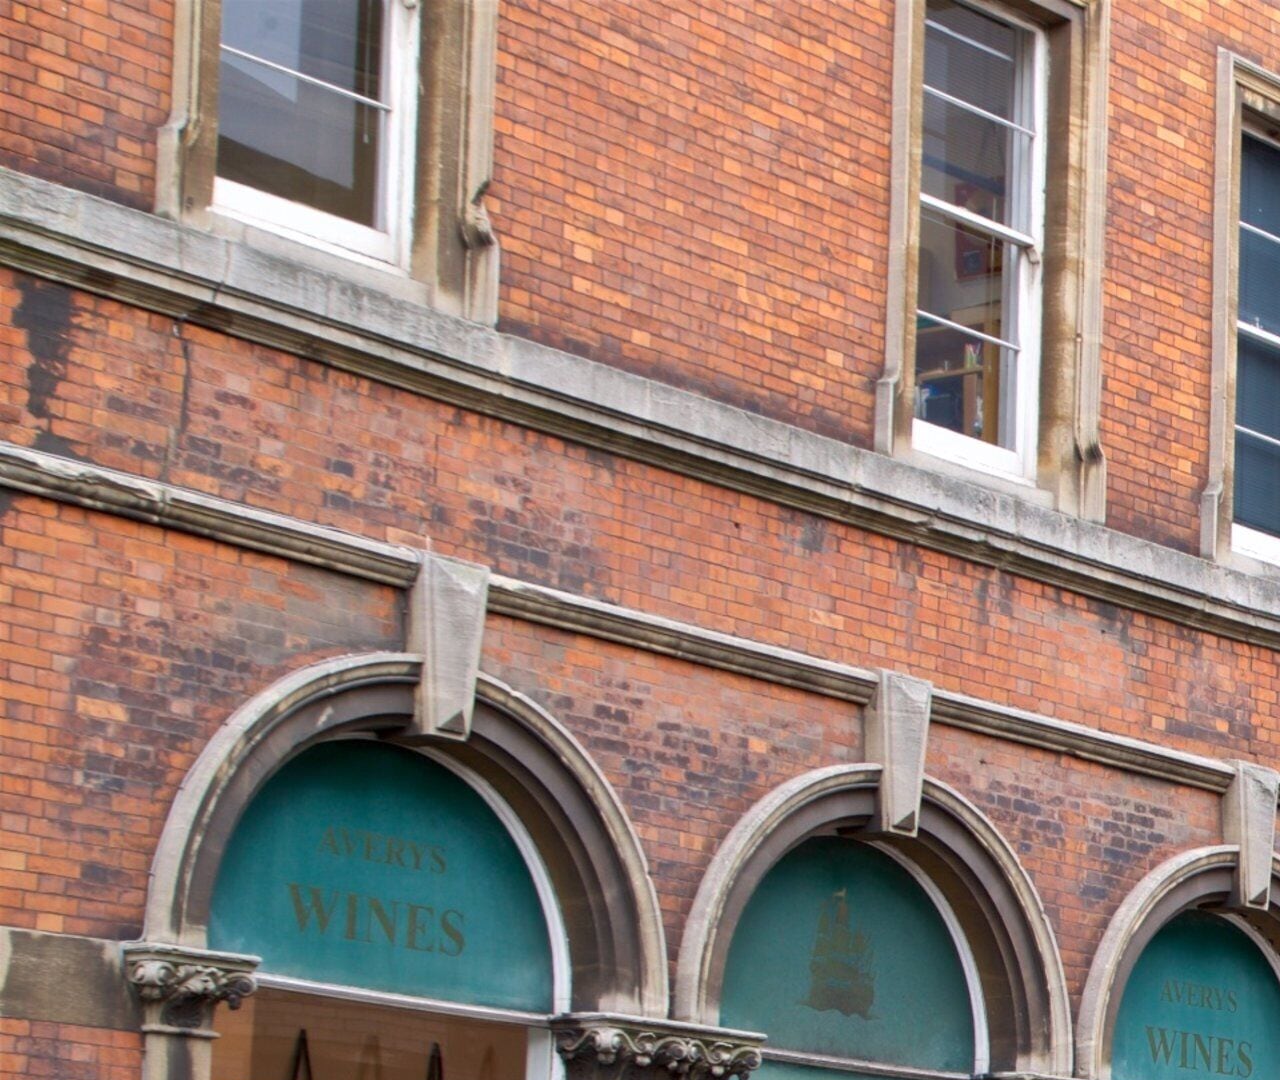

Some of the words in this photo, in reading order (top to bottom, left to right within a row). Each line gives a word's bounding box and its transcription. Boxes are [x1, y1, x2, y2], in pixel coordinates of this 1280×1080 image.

[319, 826, 447, 875] AVERYS
[287, 883, 466, 957] WINES
[1160, 979, 1239, 1013] AVERYS
[1145, 1025, 1253, 1078] WINES
